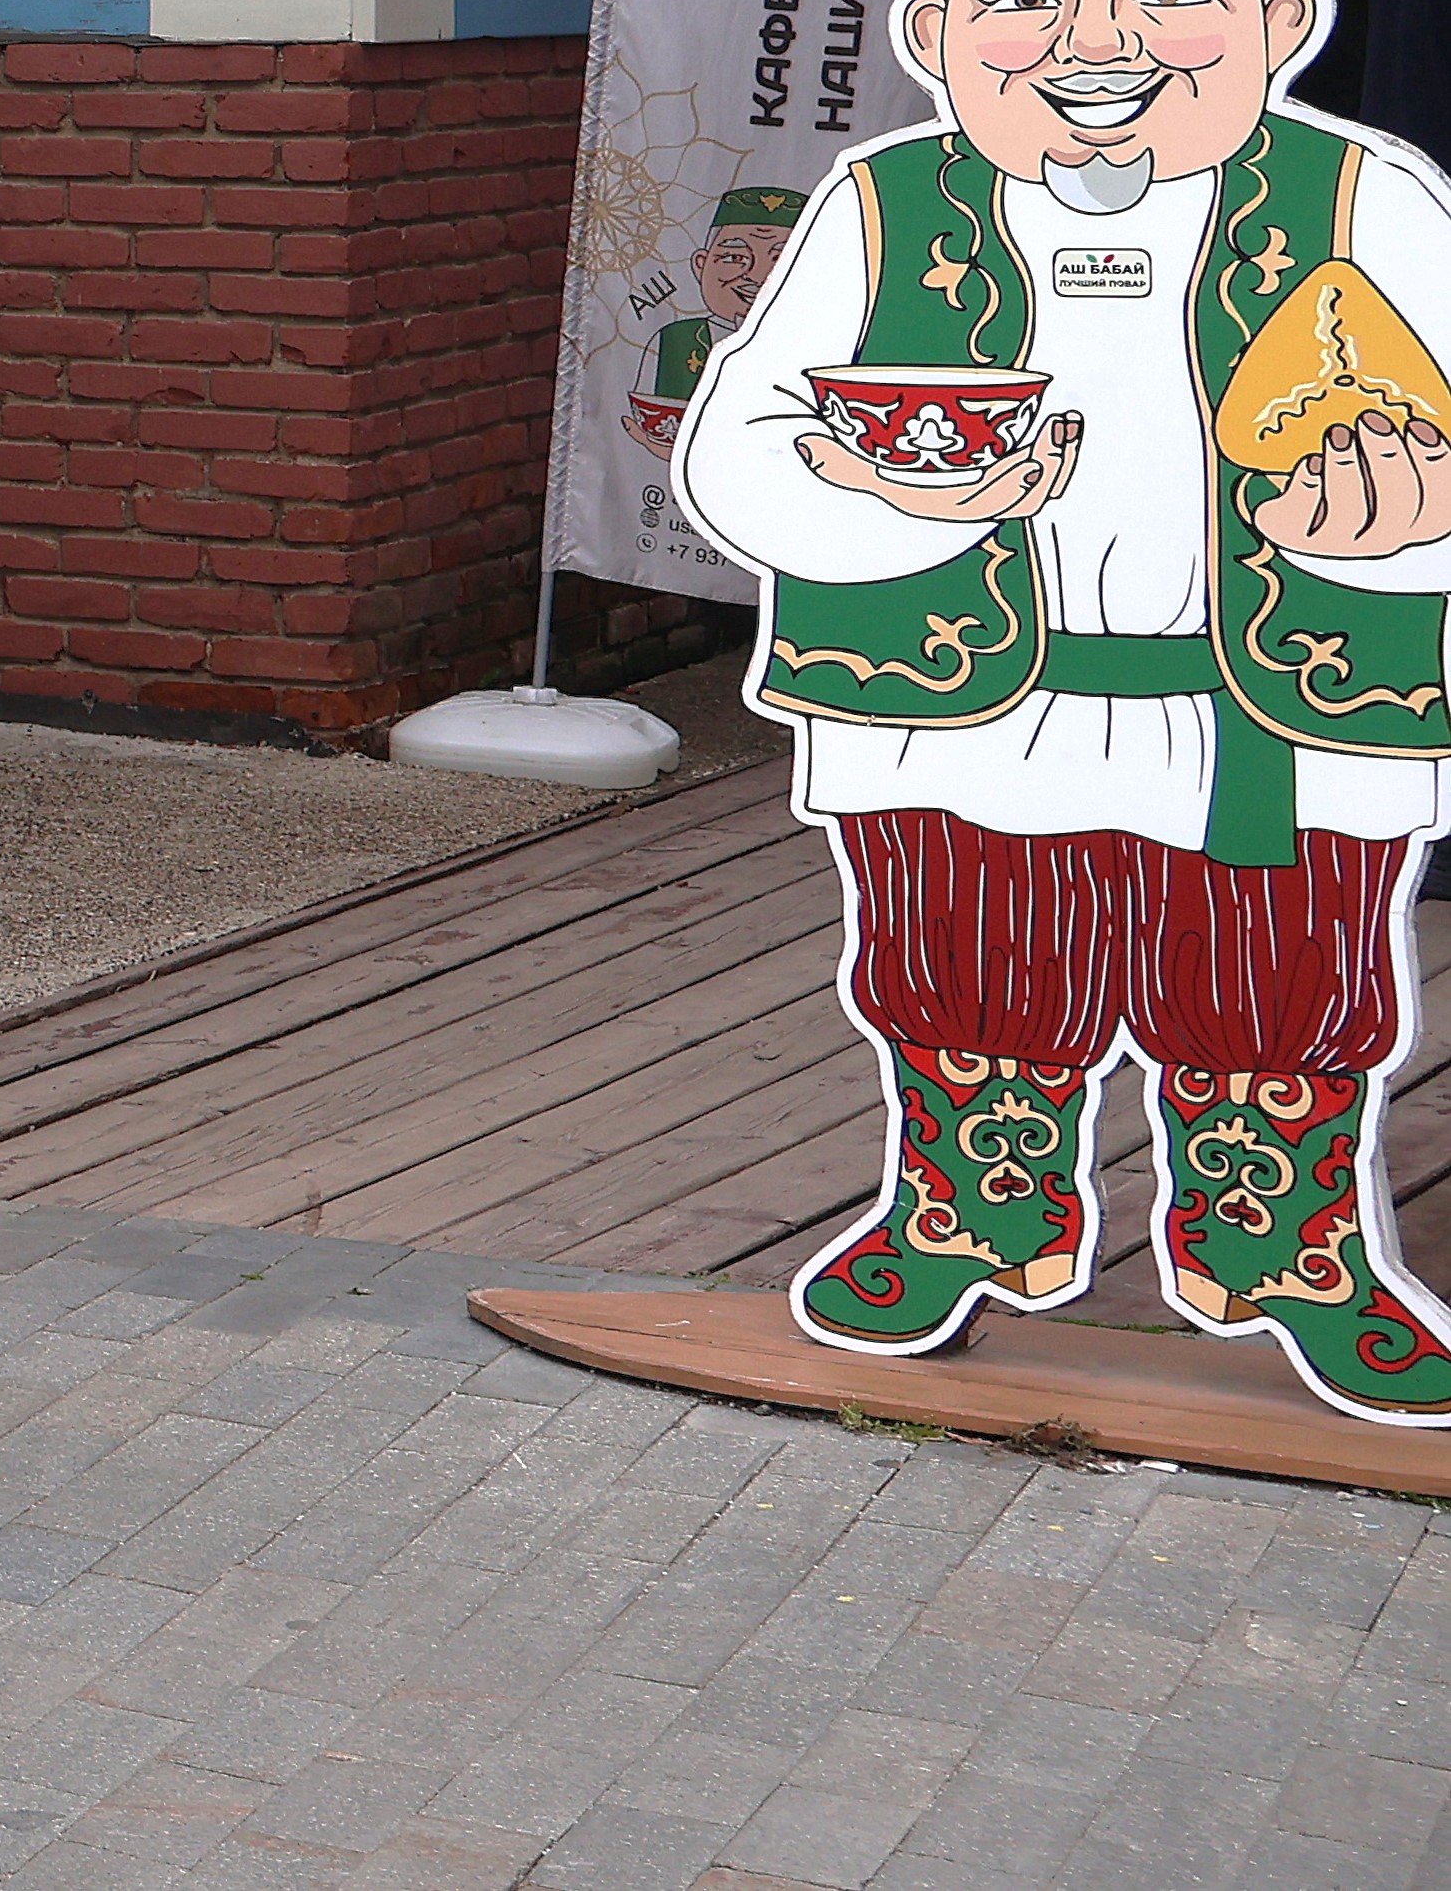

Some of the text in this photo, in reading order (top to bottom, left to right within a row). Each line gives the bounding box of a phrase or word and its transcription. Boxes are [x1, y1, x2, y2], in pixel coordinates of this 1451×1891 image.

[1059, 262, 1145, 274] АШ БАБАЙ
[1059, 278, 1147, 288] ЛУЧШИЙ ПОВАР
[628, 270, 677, 321] АШ
[667, 544, 690, 559] +7
